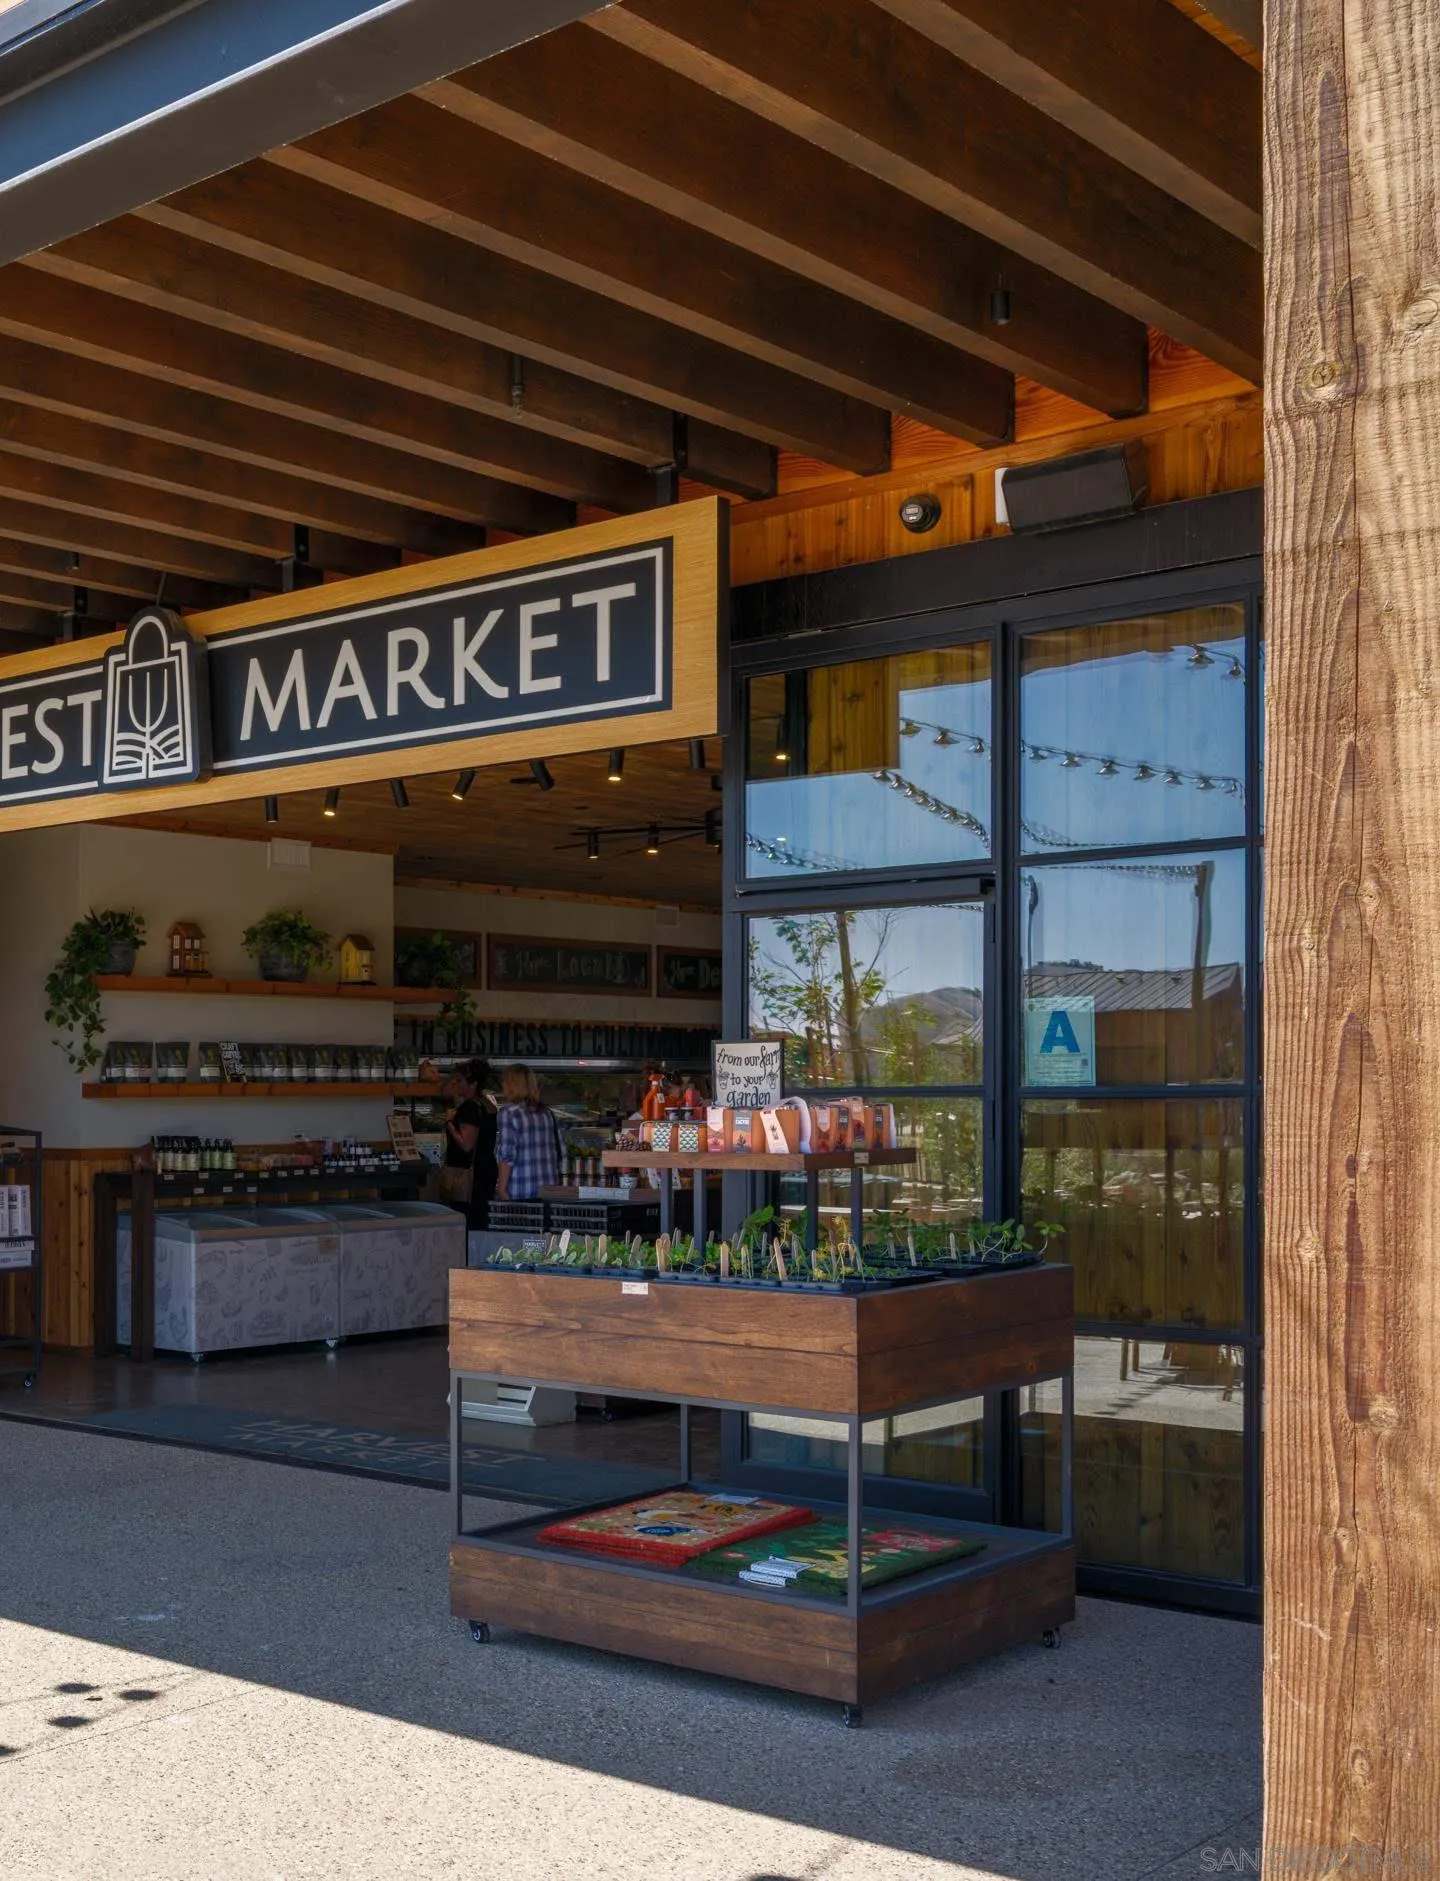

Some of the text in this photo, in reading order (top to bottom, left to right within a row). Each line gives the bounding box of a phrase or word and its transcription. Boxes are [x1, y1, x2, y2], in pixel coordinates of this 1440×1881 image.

[239, 582, 637, 741] MARKET
[1039, 1010, 1081, 1054] A
[717, 1048, 742, 1066] from
[744, 1055, 760, 1067] our
[726, 1086, 771, 1107] garden
[730, 1073, 764, 1088] to your
[239, 1418, 547, 1465] HARVEST
